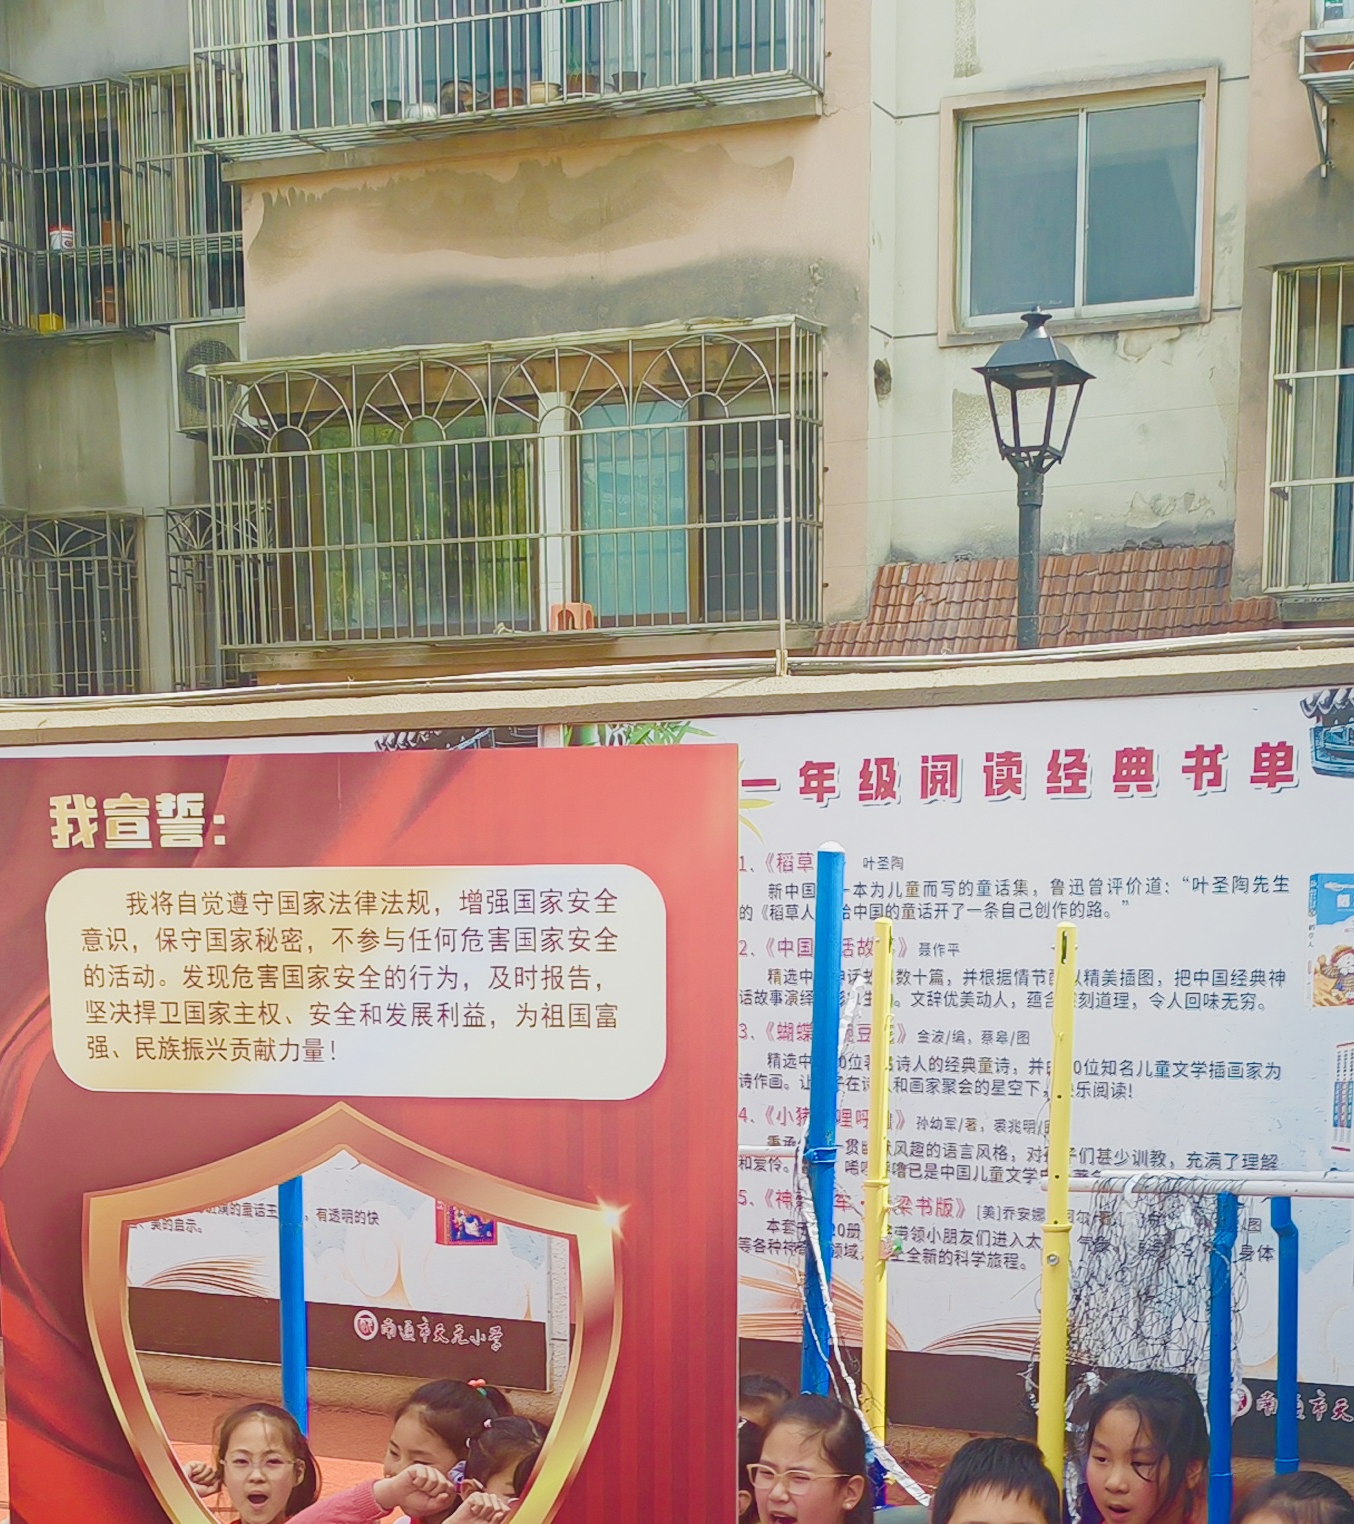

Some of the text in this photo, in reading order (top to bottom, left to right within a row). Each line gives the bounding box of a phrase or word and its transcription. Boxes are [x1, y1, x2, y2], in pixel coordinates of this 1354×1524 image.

[741, 742, 1297, 804] 一年级阅读经典书单
[48, 792, 227, 851] 我宣誓：
[863, 856, 904, 871] 叶圣陶
[768, 874, 1291, 898] 新中国本为儿童而写的童话集，鲁迅曾评价道：“叶圣陶先生
[125, 887, 619, 918] 我将自觉遵守国家法律法规，增强国家安全
[739, 900, 1129, 921] 的《稻草人给中国的童话开了一条自己创作的路。”
[81, 925, 619, 955] 意识，保守国家秘密，不参与任何危害国家安全
[739, 937, 961, 958] 2、《中国话故》 聂作平
[84, 963, 604, 993] 的活动。发现危害国家安全的行为，及时报告，
[85, 1001, 619, 1030] 坚决捍卫国家主权、安全和发展利益，为祖国富
[87, 1036, 338, 1064] 强、民族振兴贡献力量！
[738, 1106, 905, 1130] 4、《小猪哩呼》
